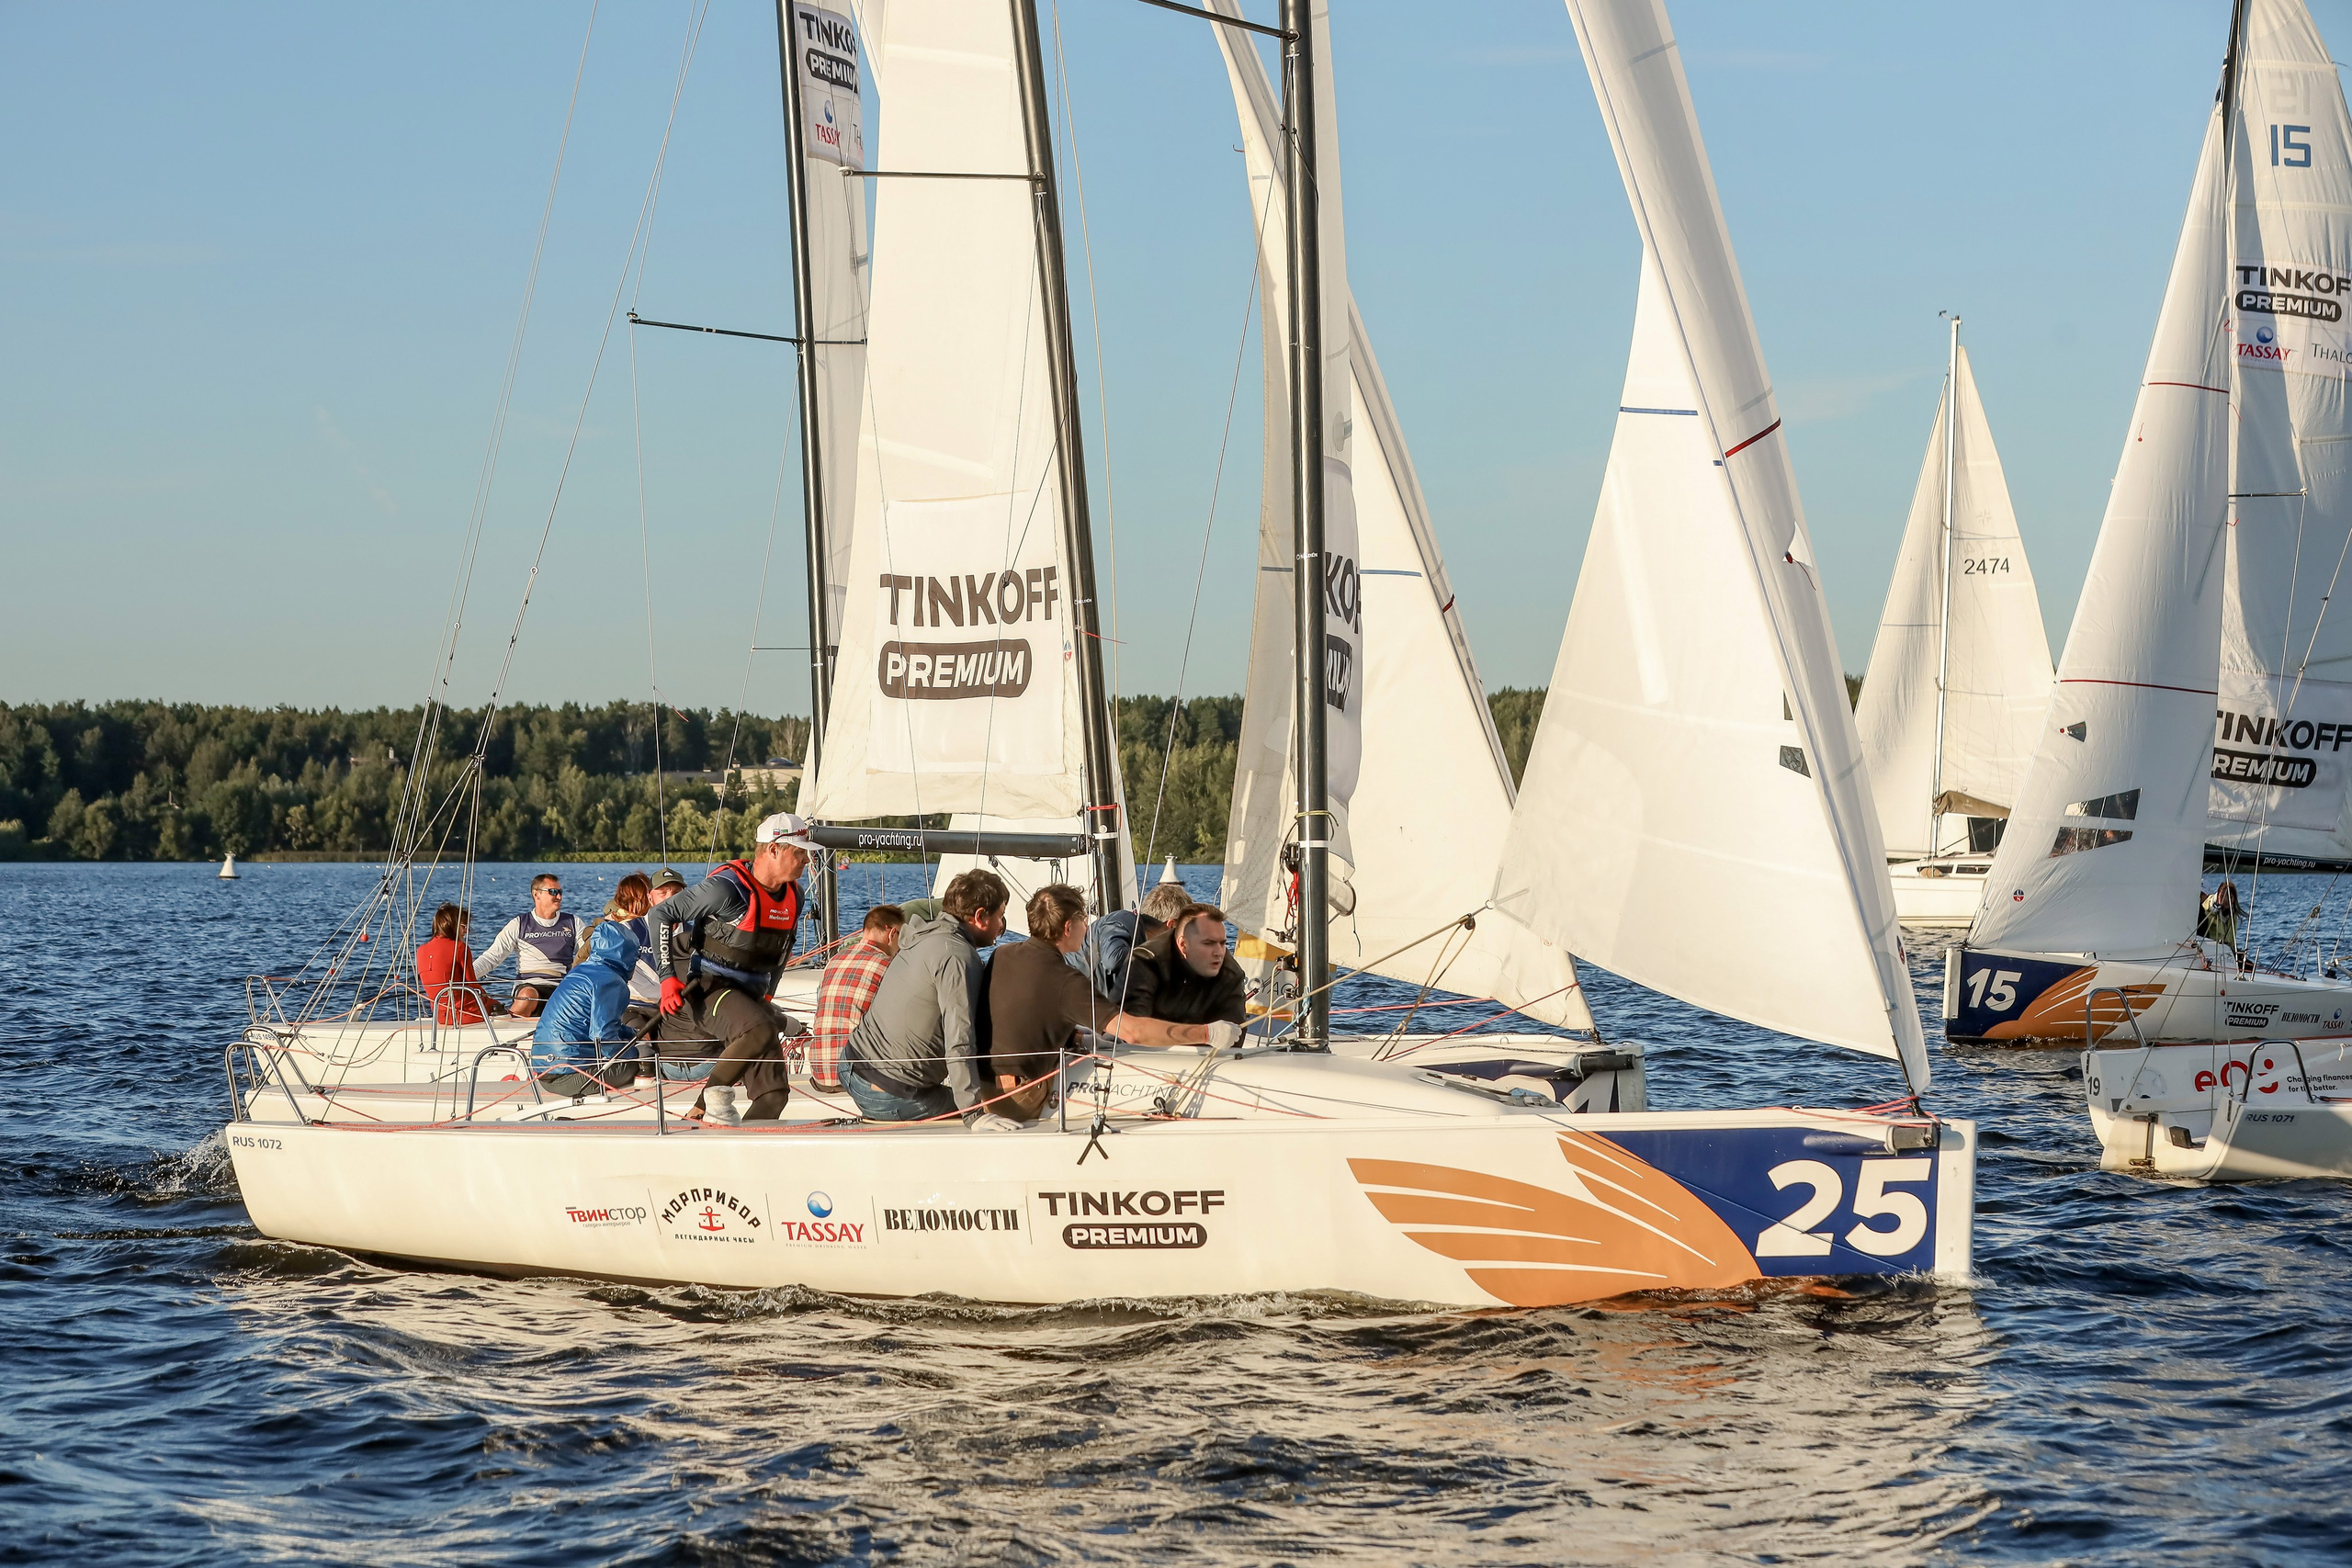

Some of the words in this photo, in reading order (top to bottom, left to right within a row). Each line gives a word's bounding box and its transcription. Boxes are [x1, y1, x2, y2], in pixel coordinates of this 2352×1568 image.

[2270, 125, 2311, 167] 15
[2243, 294, 2335, 319] PREMIUM
[2237, 344, 2290, 360] TASSAY
[1964, 558, 2009, 574] 2474
[880, 566, 1057, 626] TINKOFF
[887, 650, 1024, 688] PREMIUM
[2217, 710, 2352, 751] INKOFF
[858, 833, 922, 850] pro-yachting.ru
[2263, 856, 2316, 869] pro-yachting.ru
[1967, 968, 2022, 1011] 15
[2087, 1076, 2100, 1097] 19
[2287, 1075, 2322, 1083] Chaging
[2245, 1114, 2268, 1122] RUS
[2272, 1114, 2295, 1122] 1071
[232, 1136, 254, 1147] RUS
[257, 1138, 282, 1149] 1072
[662, 1188, 761, 1228] МОРПРИБОР
[1038, 1190, 1225, 1216] TINKOFF
[1756, 1159, 1931, 1257] 25
[883, 1208, 1020, 1233] ВЕДОМОСТИ
[674, 1234, 729, 1242] ЛЕГЕНДАРНЫЕ
[781, 1222, 865, 1242] TASSAY
[1071, 1227, 1198, 1245] PREMIUM
